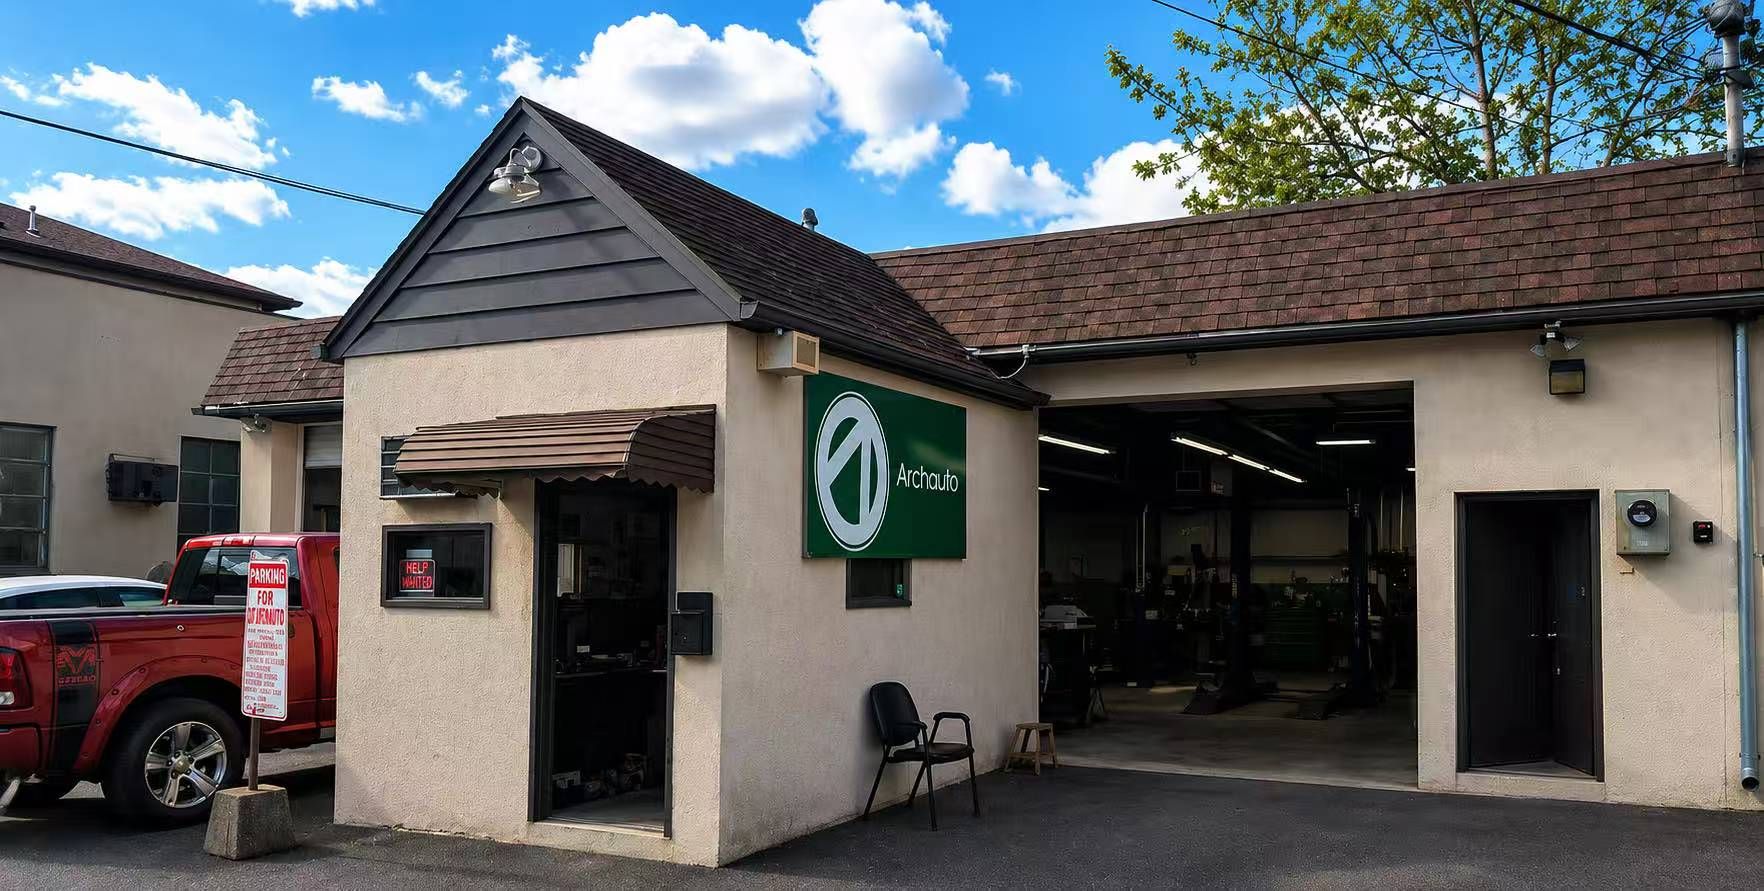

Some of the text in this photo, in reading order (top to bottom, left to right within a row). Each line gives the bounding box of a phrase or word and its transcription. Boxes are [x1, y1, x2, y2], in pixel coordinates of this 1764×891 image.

[896, 462, 959, 492] Archauto
[250, 567, 285, 585] PARKING
[406, 561, 429, 574] HELP
[257, 590, 274, 606] FOR
